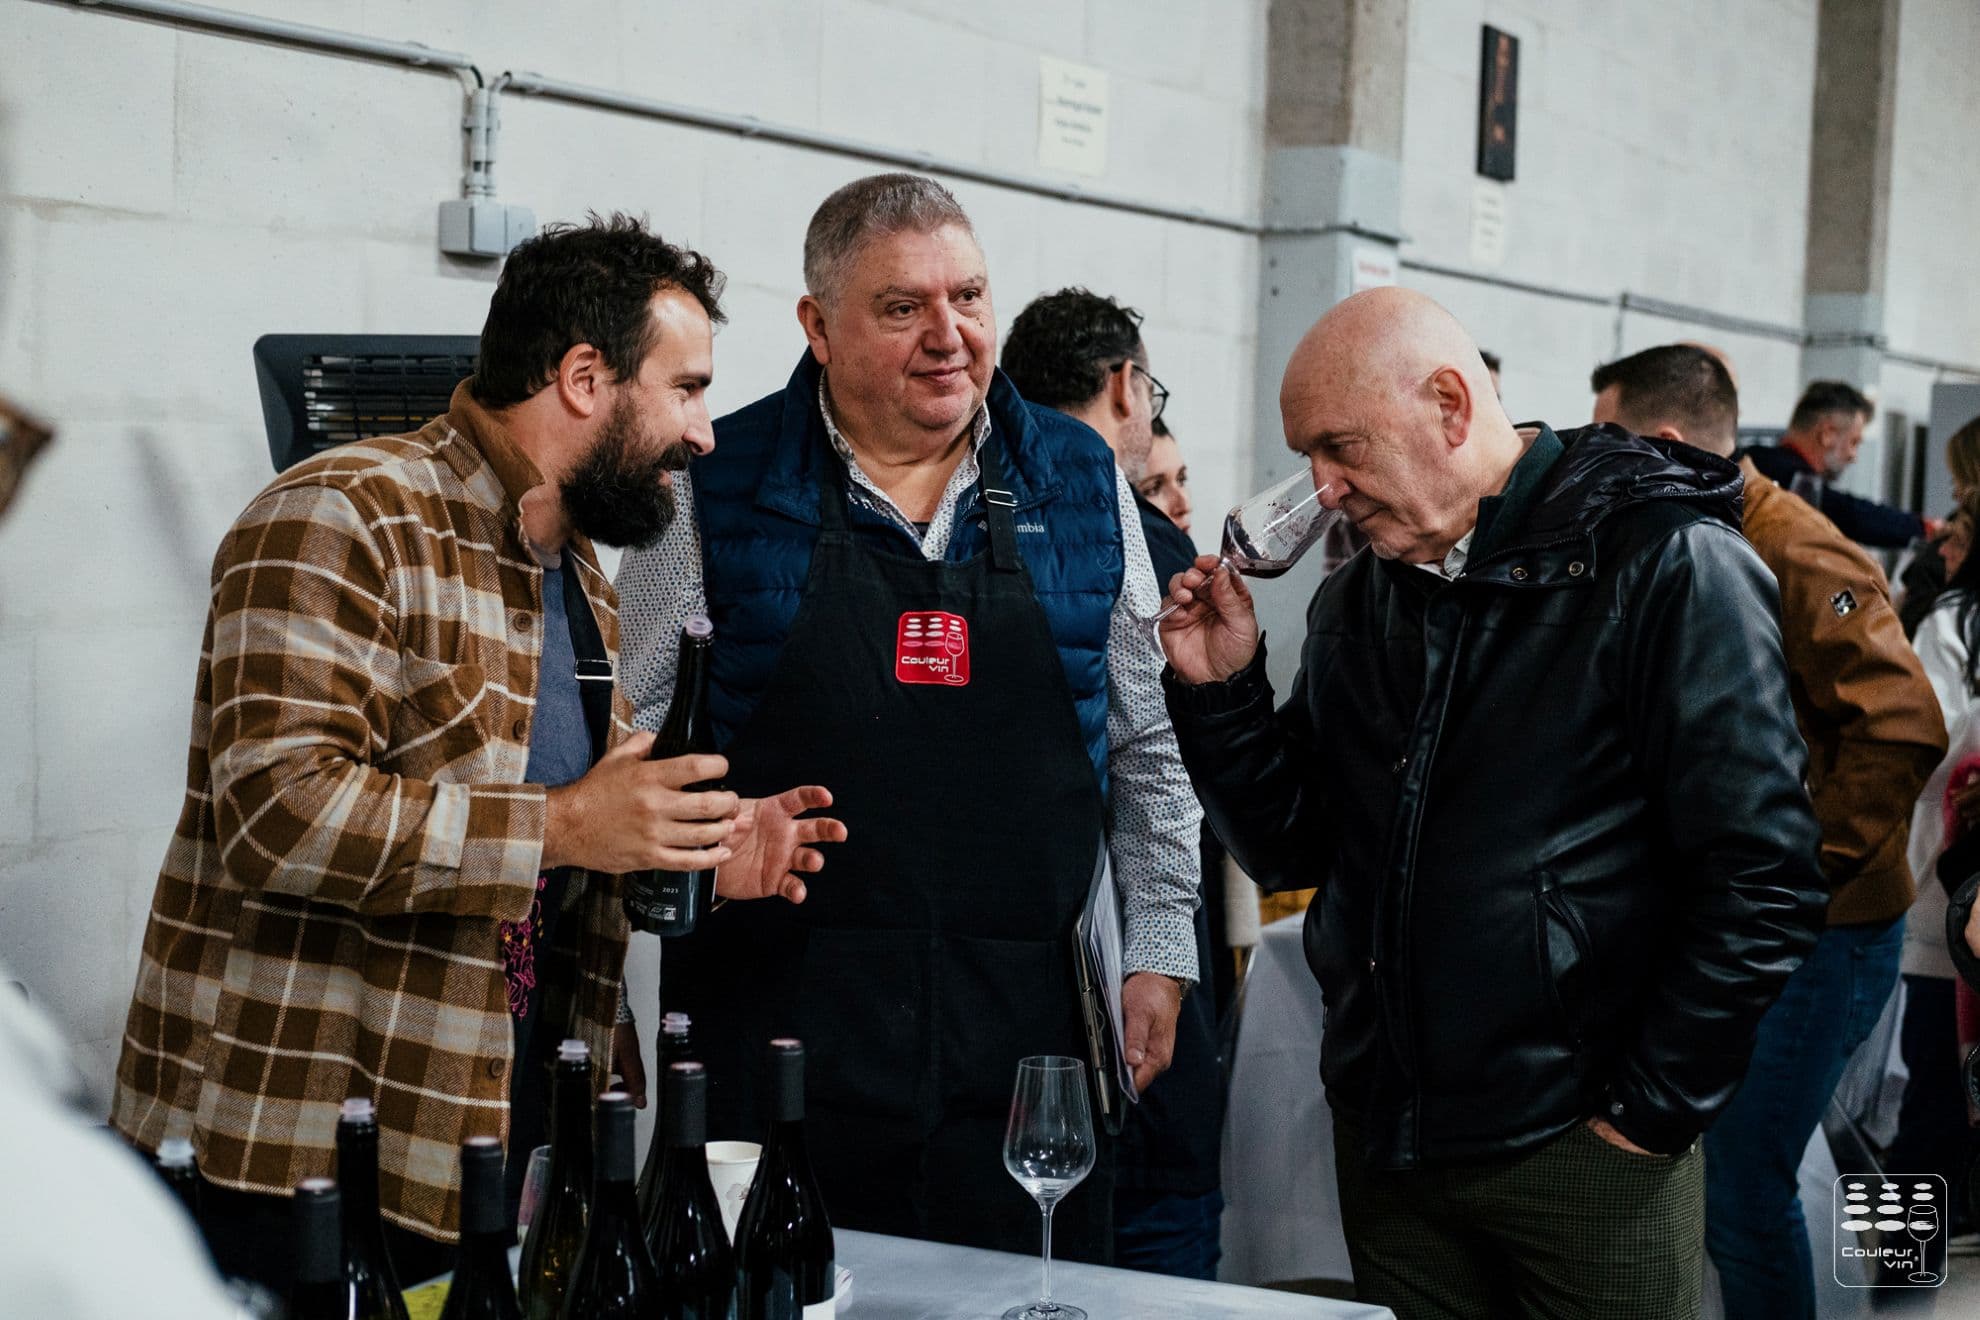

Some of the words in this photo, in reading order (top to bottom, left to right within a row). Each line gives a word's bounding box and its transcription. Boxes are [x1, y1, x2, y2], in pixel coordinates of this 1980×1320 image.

[1016, 522, 1045, 533] mbia
[901, 655, 950, 665] Couleur
[928, 665, 949, 673] vin
